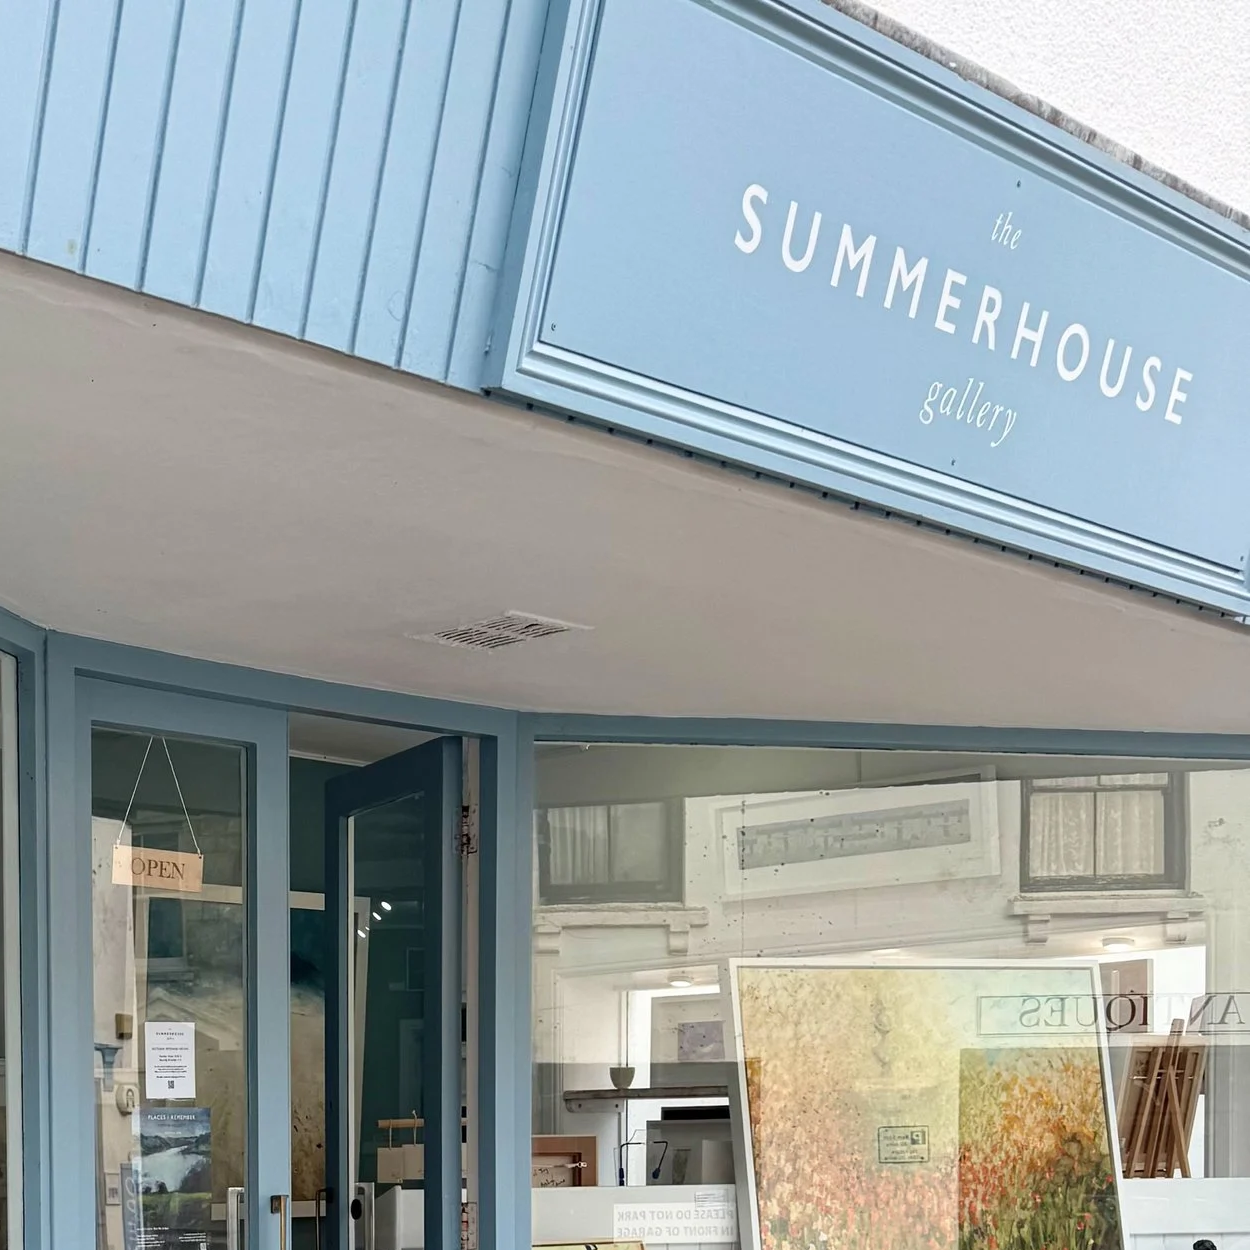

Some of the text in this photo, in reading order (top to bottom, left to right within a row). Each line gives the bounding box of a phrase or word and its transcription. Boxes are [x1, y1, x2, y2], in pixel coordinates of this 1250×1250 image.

[991, 211, 1022, 250] the
[734, 183, 1194, 425] SUMMERHOUSE
[919, 378, 1017, 448] gallery
[131, 857, 185, 880] OPEN
